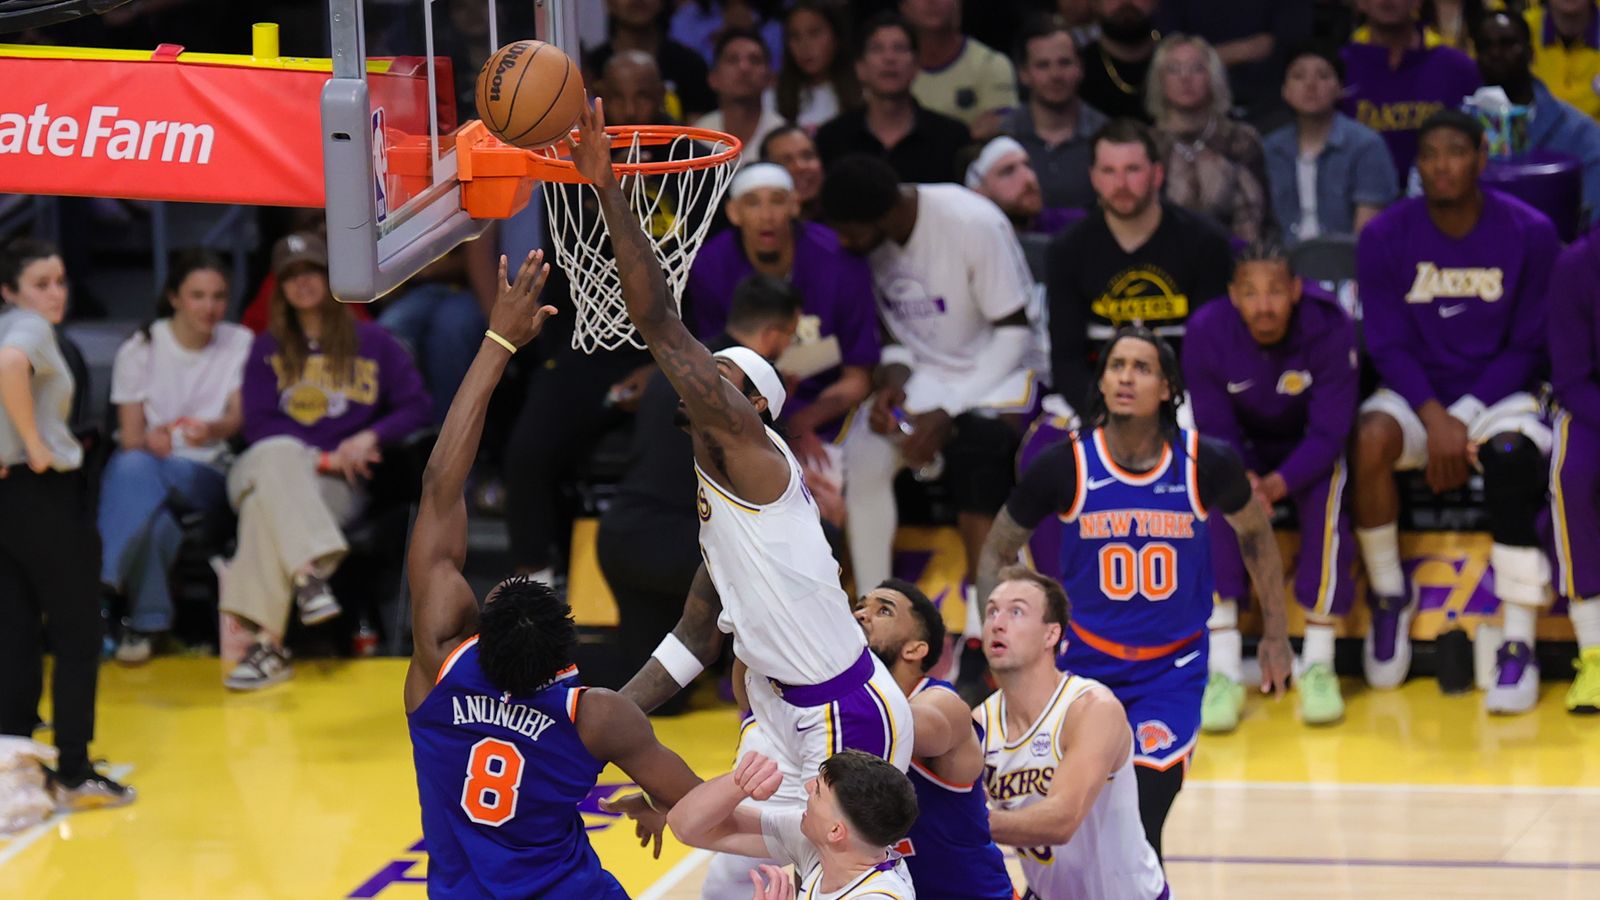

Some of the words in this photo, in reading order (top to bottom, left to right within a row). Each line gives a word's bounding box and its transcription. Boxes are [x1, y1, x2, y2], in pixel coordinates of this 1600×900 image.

[489, 42, 532, 102] Wilson
[0, 103, 79, 157] ate
[1404, 261, 1504, 304] LAKERS
[1098, 542, 1178, 602] 00
[451, 695, 556, 742] ANUNOBY
[460, 736, 526, 828] 8
